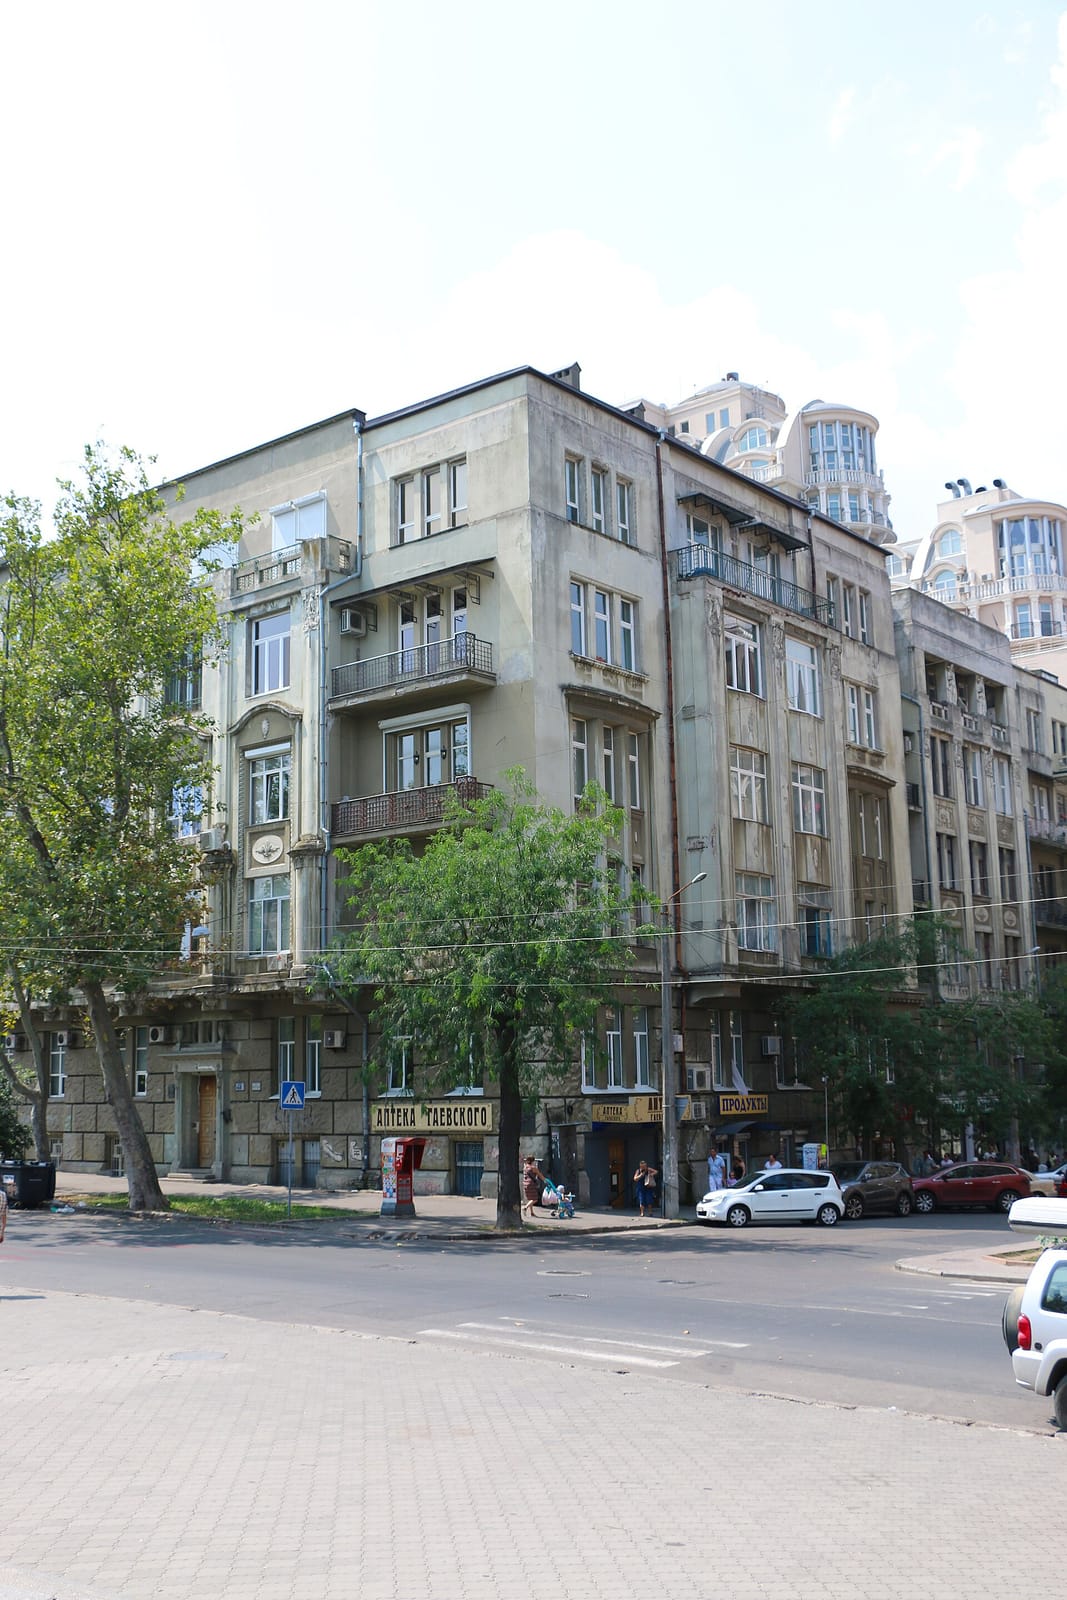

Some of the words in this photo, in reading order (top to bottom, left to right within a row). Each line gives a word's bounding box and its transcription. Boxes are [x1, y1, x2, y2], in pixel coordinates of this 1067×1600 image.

[722, 1097, 767, 1112] ПРОДУКТЫ
[376, 1108, 416, 1127] АПТЕКА
[426, 1107, 487, 1127] ГАЕВСКОГО
